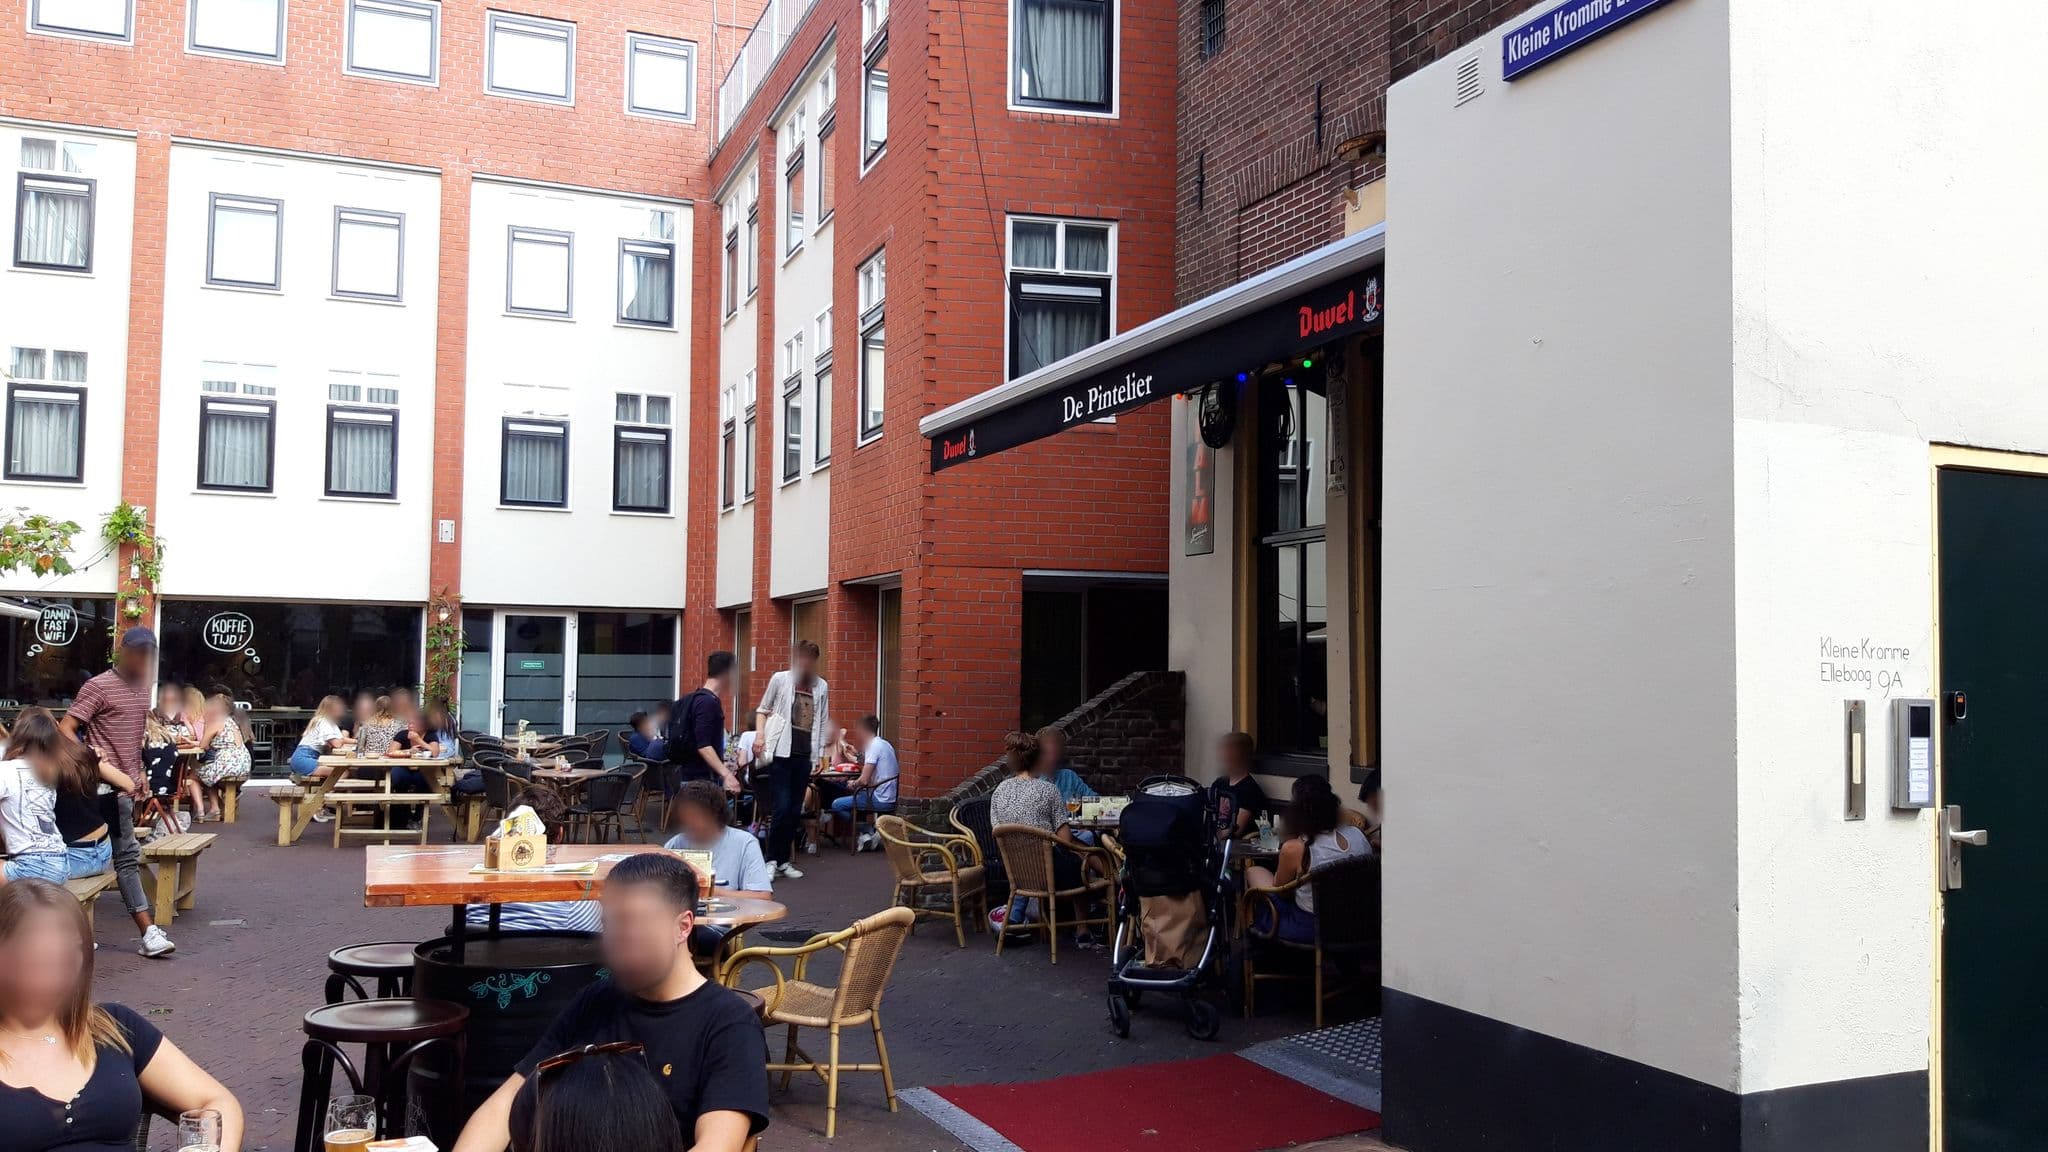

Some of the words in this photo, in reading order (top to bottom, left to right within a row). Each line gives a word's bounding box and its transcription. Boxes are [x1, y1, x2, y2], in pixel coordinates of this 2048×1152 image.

[1508, 26, 1550, 64] Kleine
[1554, 0, 1611, 41] Kromme
[1299, 289, 1355, 338] Duvel
[1062, 396, 1083, 423] De
[1087, 372, 1153, 414] Pintelier
[943, 434, 966, 460] Duvel
[43, 608, 70, 620] DAMN
[43, 620, 67, 631] FAST
[211, 618, 247, 634] KOFFIE
[43, 631, 66, 642] WIFI
[1820, 636, 1859, 659] Kleine
[1861, 638, 1910, 660] Kromme
[1820, 662, 1872, 690] Elleboog
